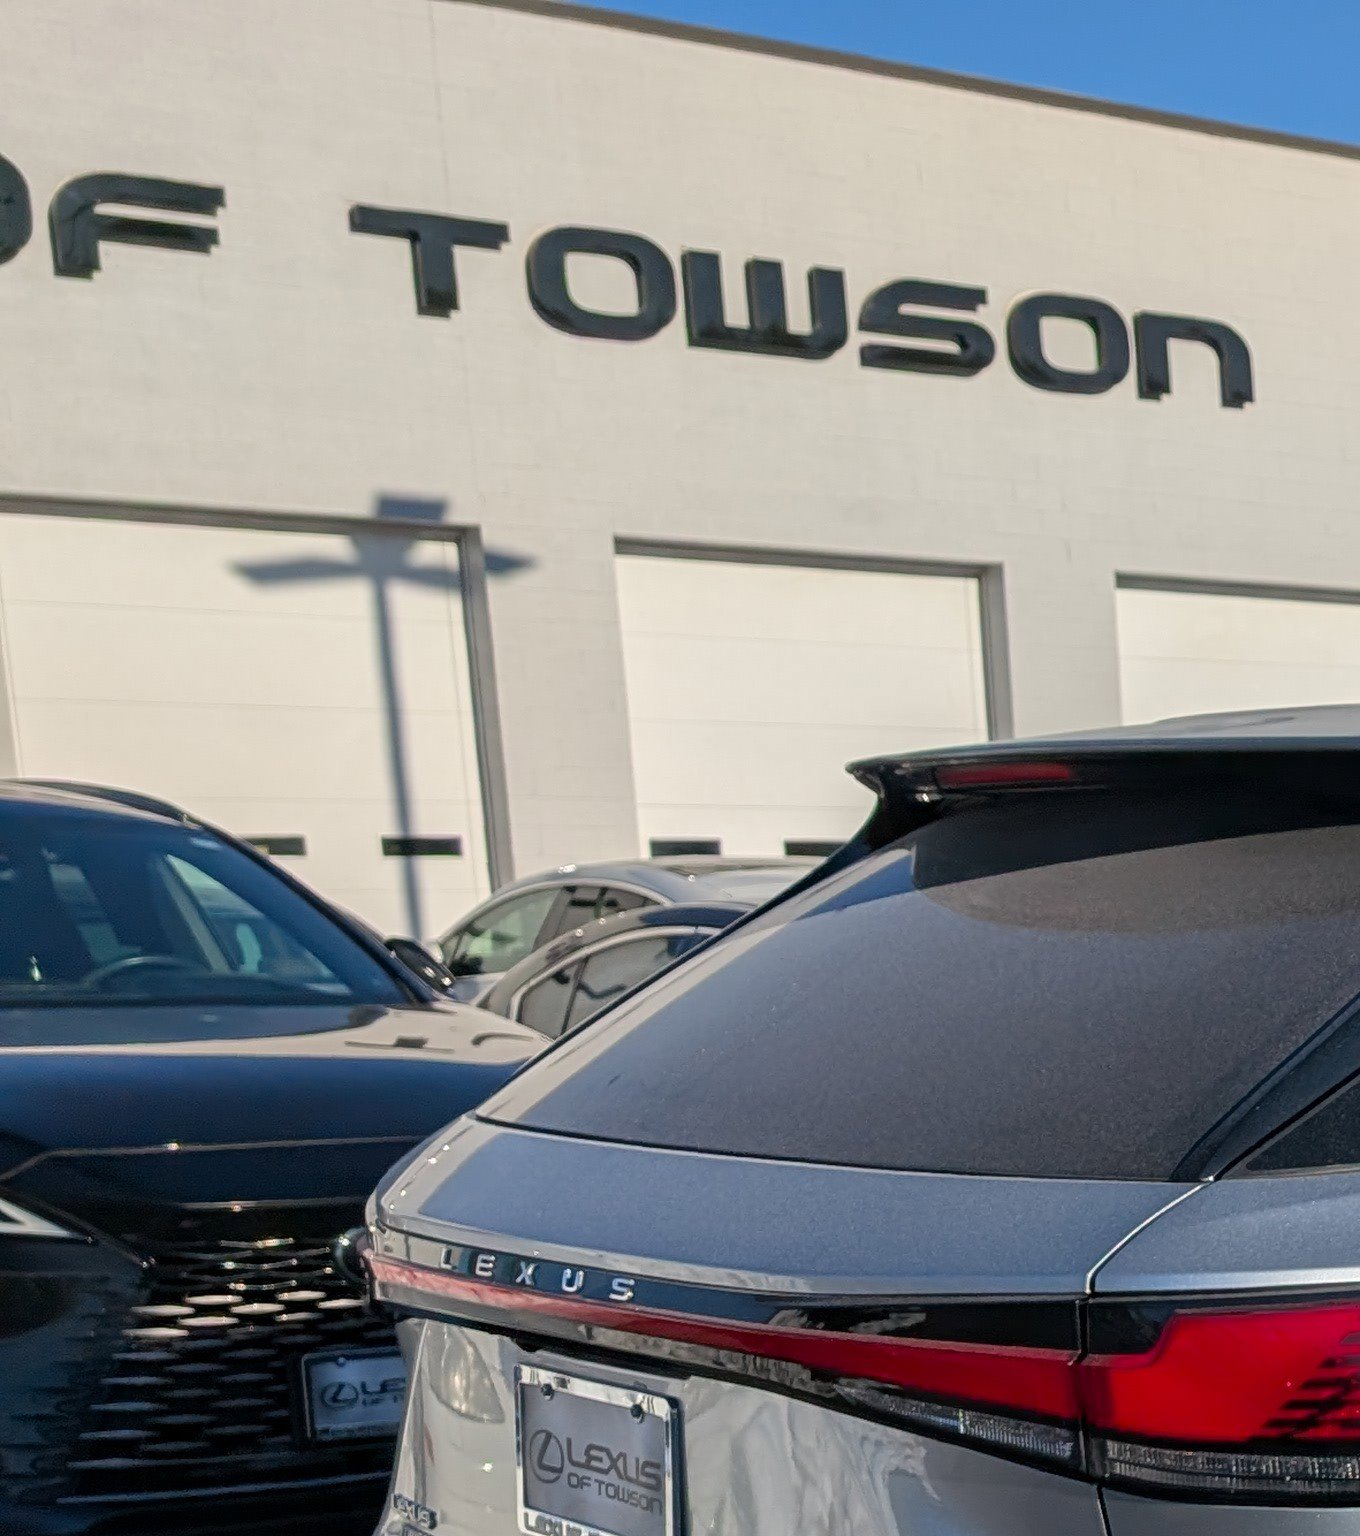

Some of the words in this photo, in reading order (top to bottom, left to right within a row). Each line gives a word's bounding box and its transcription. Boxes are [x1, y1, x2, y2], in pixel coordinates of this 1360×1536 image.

[0, 152, 226, 280] F
[347, 202, 1255, 409] TOWSON
[440, 1246, 636, 1301] LEXUS
[566, 1436, 663, 1492] LEXUS
[567, 1472, 591, 1490] OF
[594, 1478, 664, 1515] TOWSON
